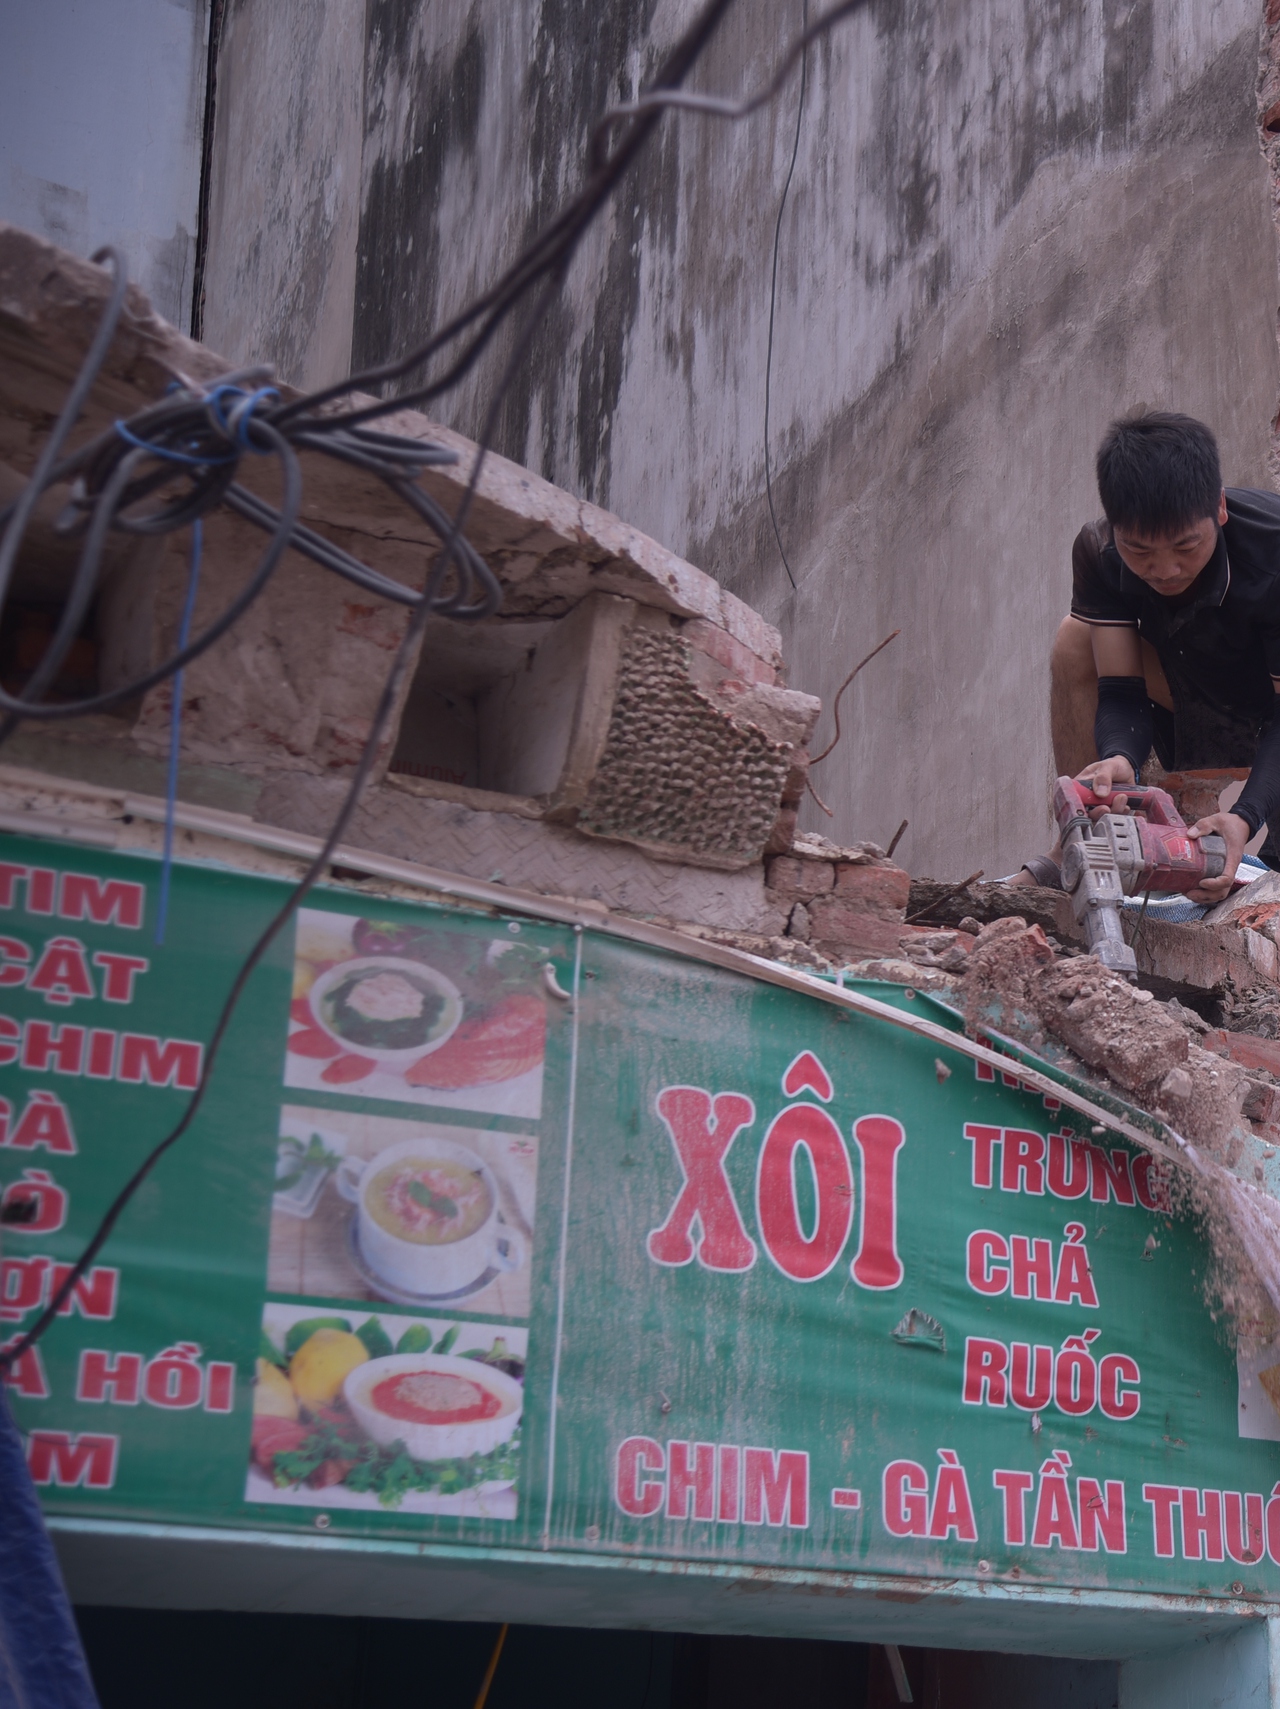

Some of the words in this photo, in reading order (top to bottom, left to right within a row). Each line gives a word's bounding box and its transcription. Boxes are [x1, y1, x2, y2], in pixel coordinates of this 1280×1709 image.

[647, 1049, 906, 1290] XÔI
[963, 1122, 1174, 1214] TRỨNG
[965, 1223, 1100, 1309] CHẢ
[962, 1329, 1141, 1421] RUỐC
[614, 1435, 810, 1529] CHIM
[882, 1448, 978, 1543] GÀ
[993, 1449, 1127, 1555] TẦN
